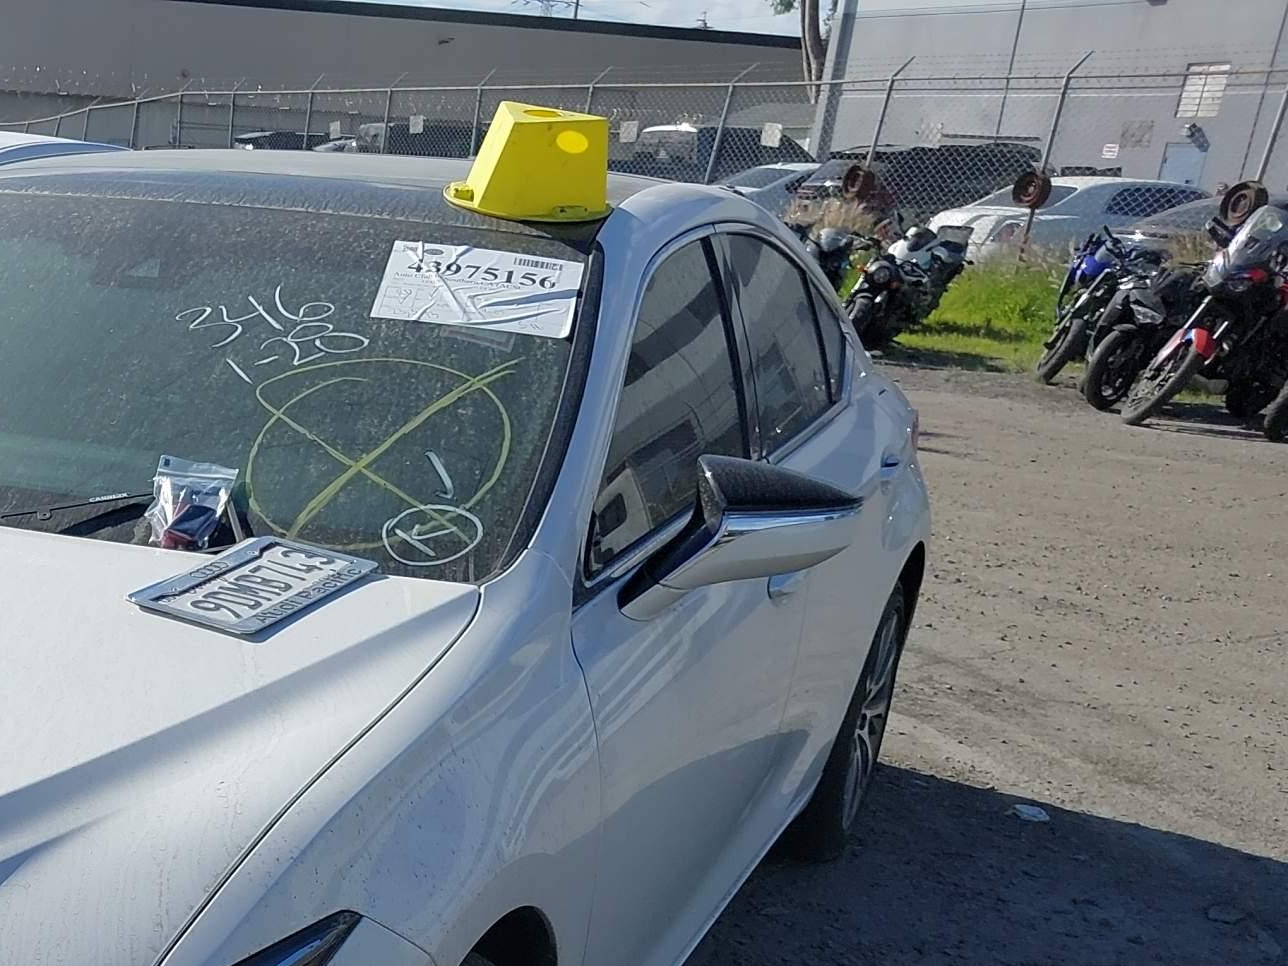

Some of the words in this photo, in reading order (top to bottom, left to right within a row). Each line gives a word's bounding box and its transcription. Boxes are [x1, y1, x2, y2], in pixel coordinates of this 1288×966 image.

[407, 260, 557, 290] 43975156
[189, 547, 336, 619] 9DMB743
[300, 568, 363, 600] Pacific
